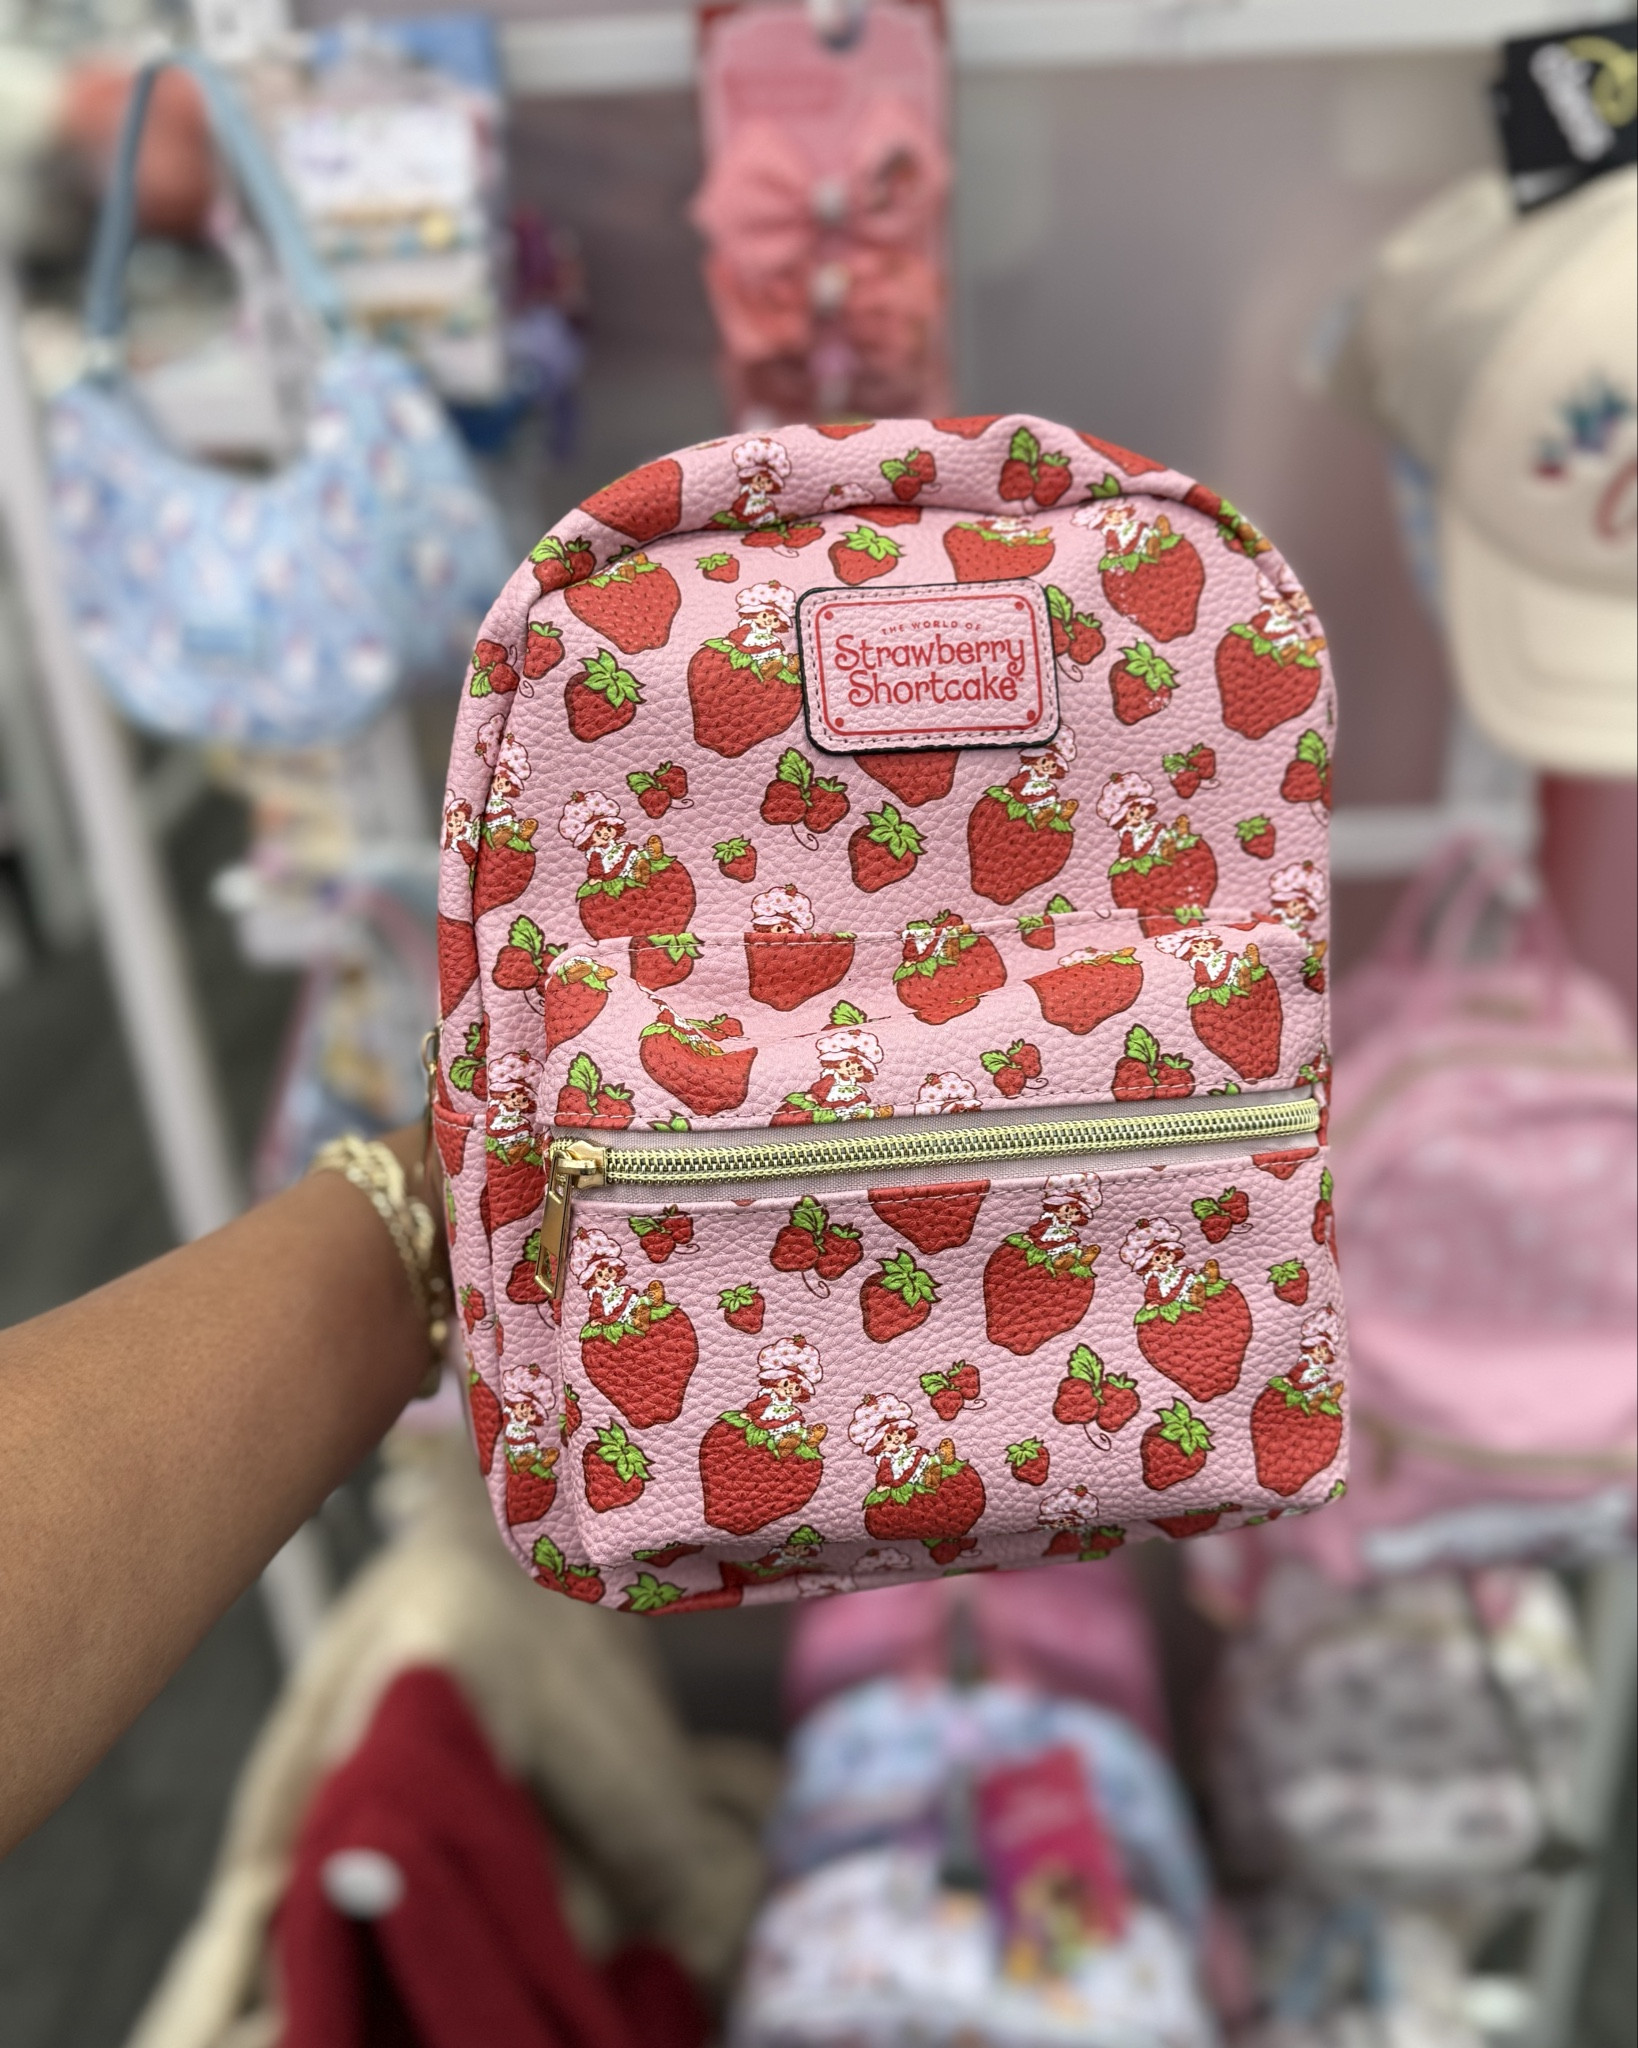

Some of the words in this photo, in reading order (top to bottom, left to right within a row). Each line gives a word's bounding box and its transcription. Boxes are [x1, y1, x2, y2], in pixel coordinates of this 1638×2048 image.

[882, 624, 904, 635] THE
[911, 619, 958, 630] WORLD
[965, 622, 983, 632] OF
[834, 633, 1026, 678] Strawberry
[848, 666, 1019, 707] Shortcake
